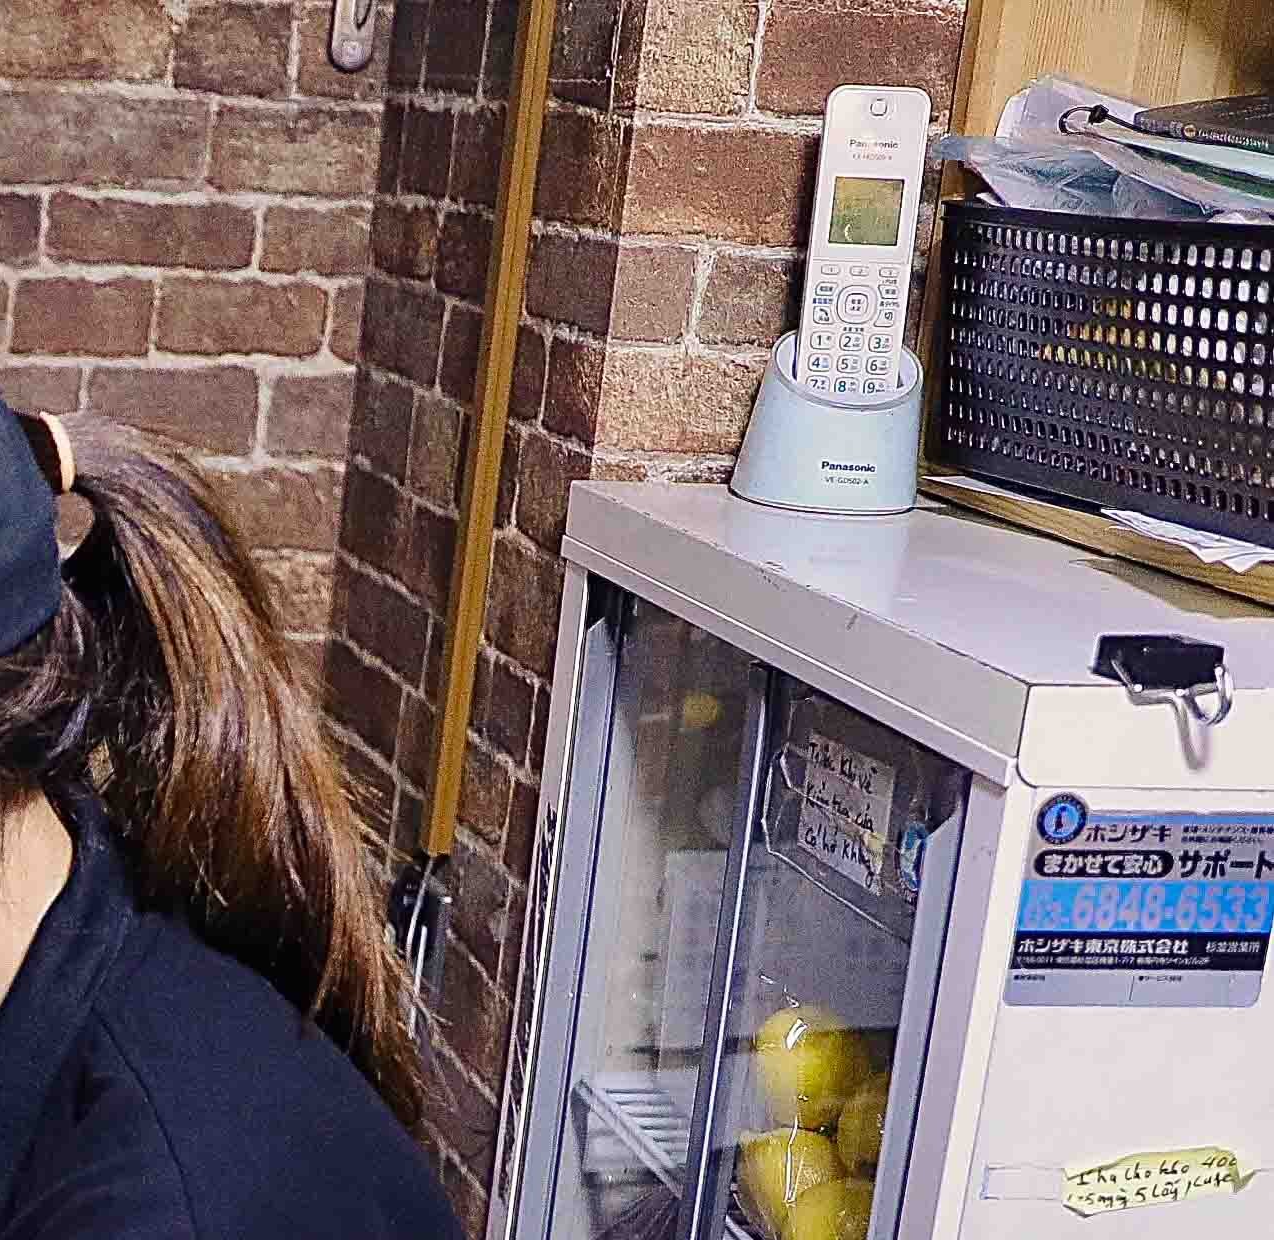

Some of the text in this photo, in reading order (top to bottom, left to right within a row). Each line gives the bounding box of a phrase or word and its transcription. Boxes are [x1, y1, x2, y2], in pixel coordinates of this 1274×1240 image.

[816, 335, 882, 349] 1 2 3
[811, 357, 878, 371] 4 5 6
[810, 379, 876, 394] 7 8 9
[821, 461, 876, 472] Panasonic
[1085, 824, 1171, 843] ホシザキ
[1043, 849, 1274, 879] まかせて安心 サポート
[1023, 883, 1269, 929] 03-6848-6533
[1017, 938, 1189, 954] ホシザキ東京株式会社
